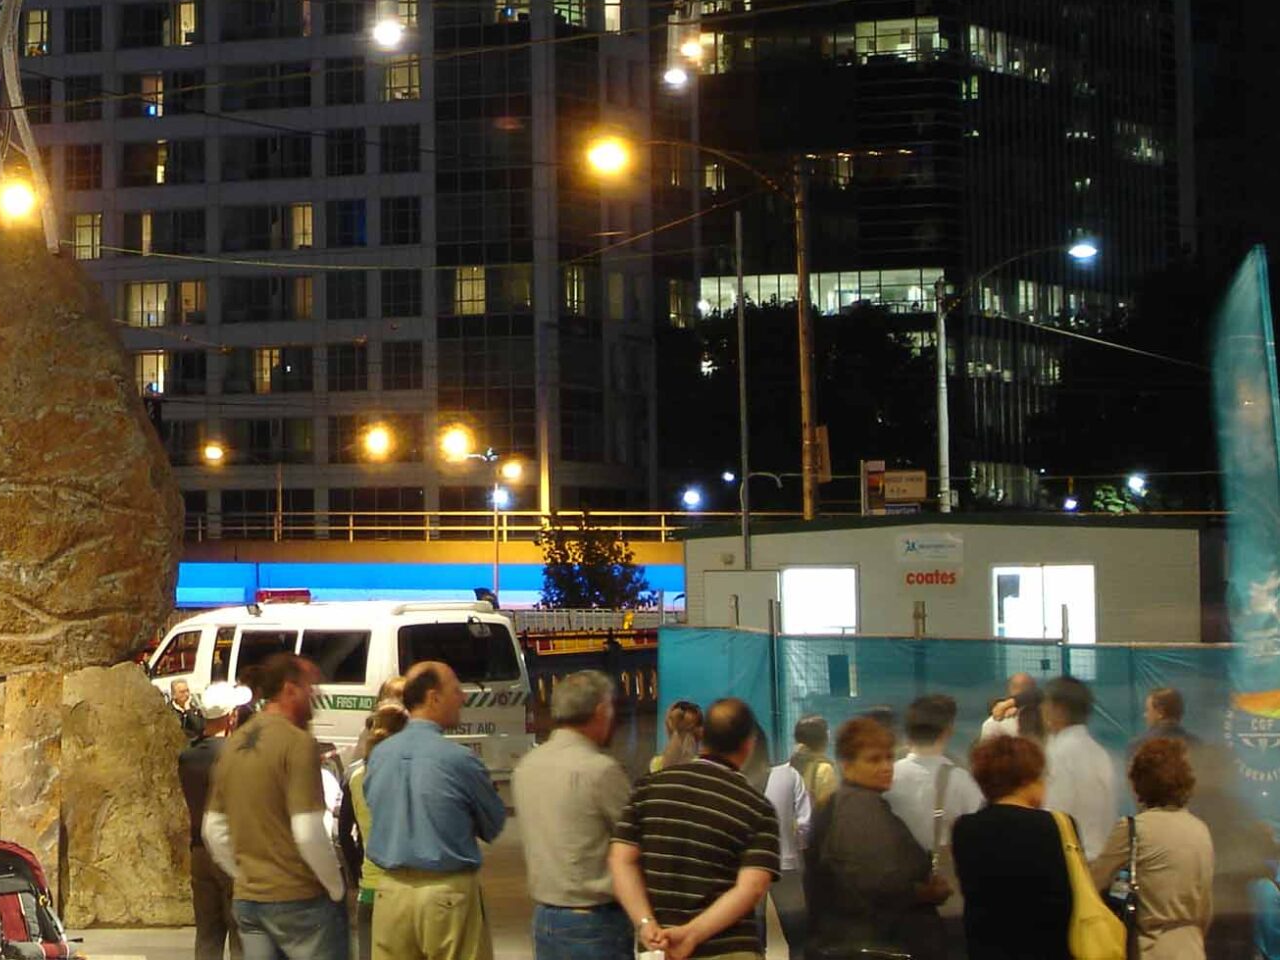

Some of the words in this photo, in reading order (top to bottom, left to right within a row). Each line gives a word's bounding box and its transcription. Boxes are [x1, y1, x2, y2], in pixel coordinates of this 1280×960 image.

[906, 569, 956, 585] coates
[336, 696, 358, 709] FIRST
[359, 696, 373, 710] AID
[446, 723, 472, 735] IRST
[477, 722, 496, 734] AID
